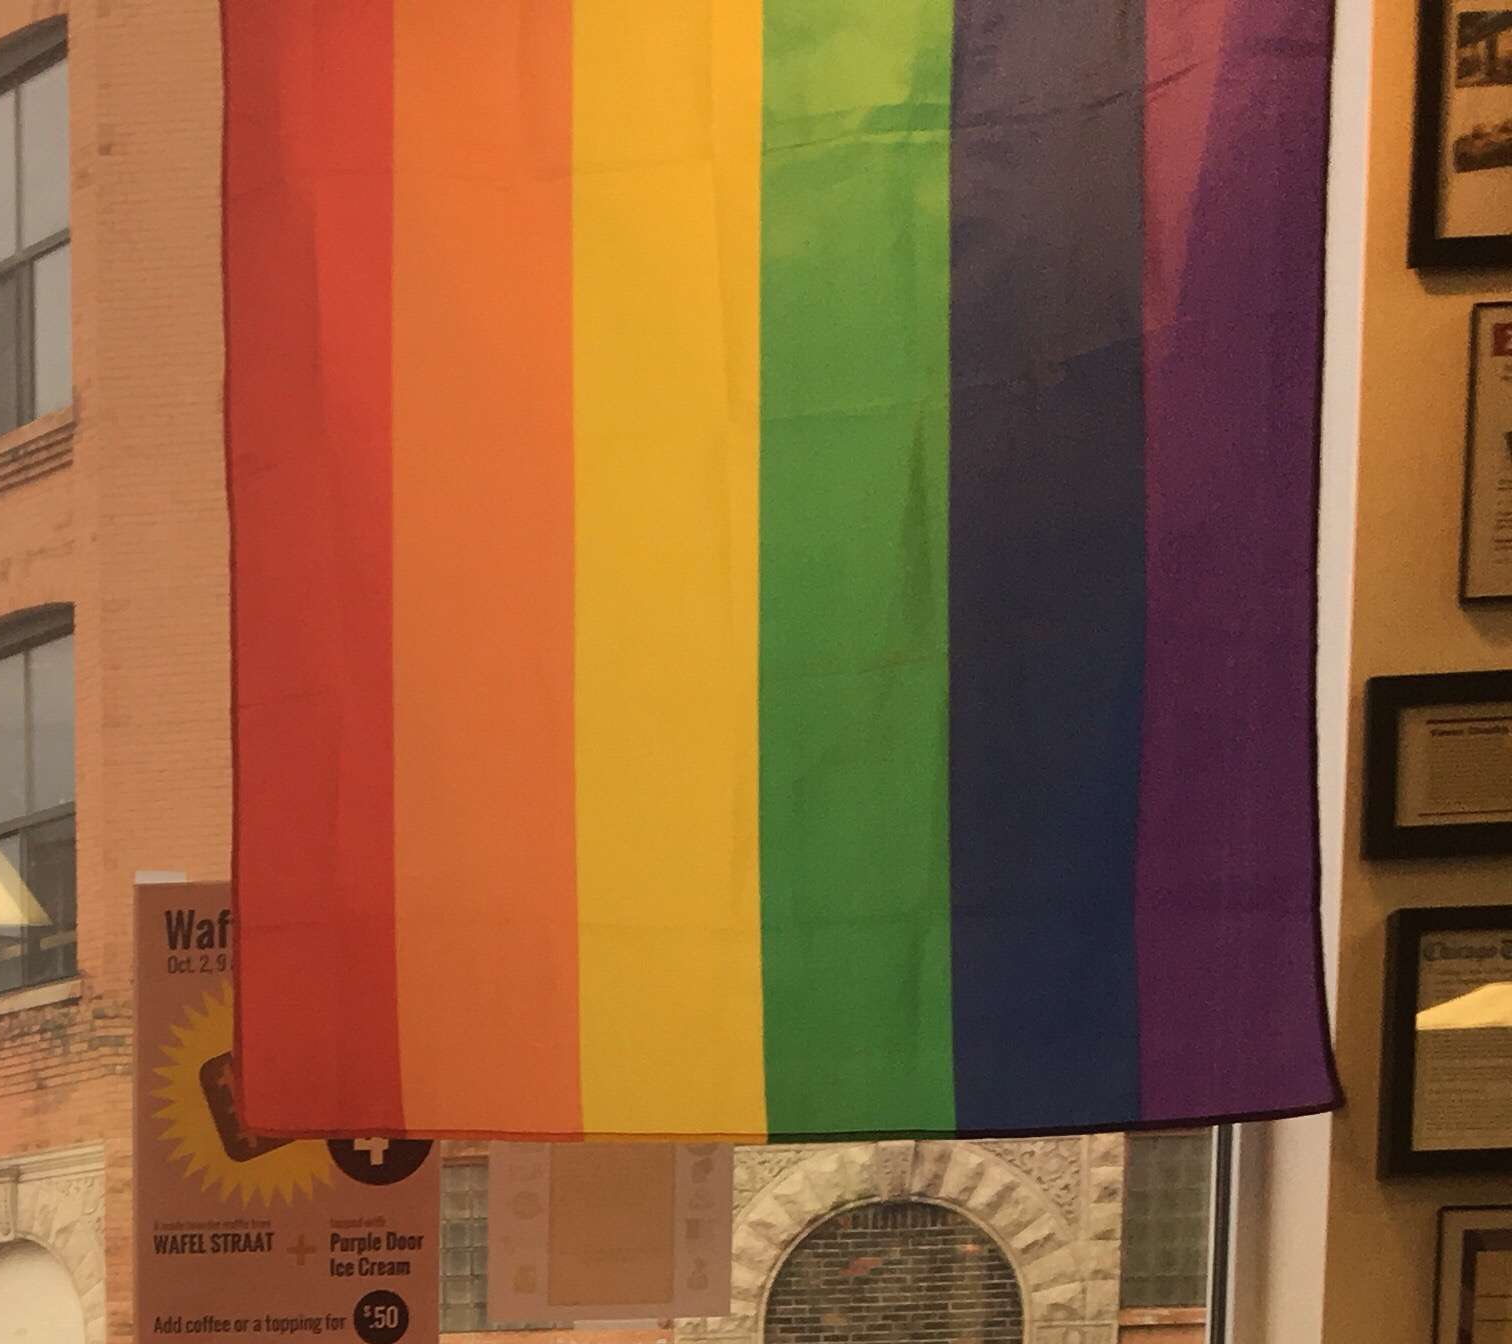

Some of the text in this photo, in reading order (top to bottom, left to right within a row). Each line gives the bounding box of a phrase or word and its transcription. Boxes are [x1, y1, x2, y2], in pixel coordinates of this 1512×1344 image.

[153, 1232, 275, 1255] WAFEL STRAAT
[330, 1231, 424, 1255] Purple Door
[330, 1257, 410, 1277] Ice Cream
[153, 1313, 346, 1335] Add coffee or a topping for
